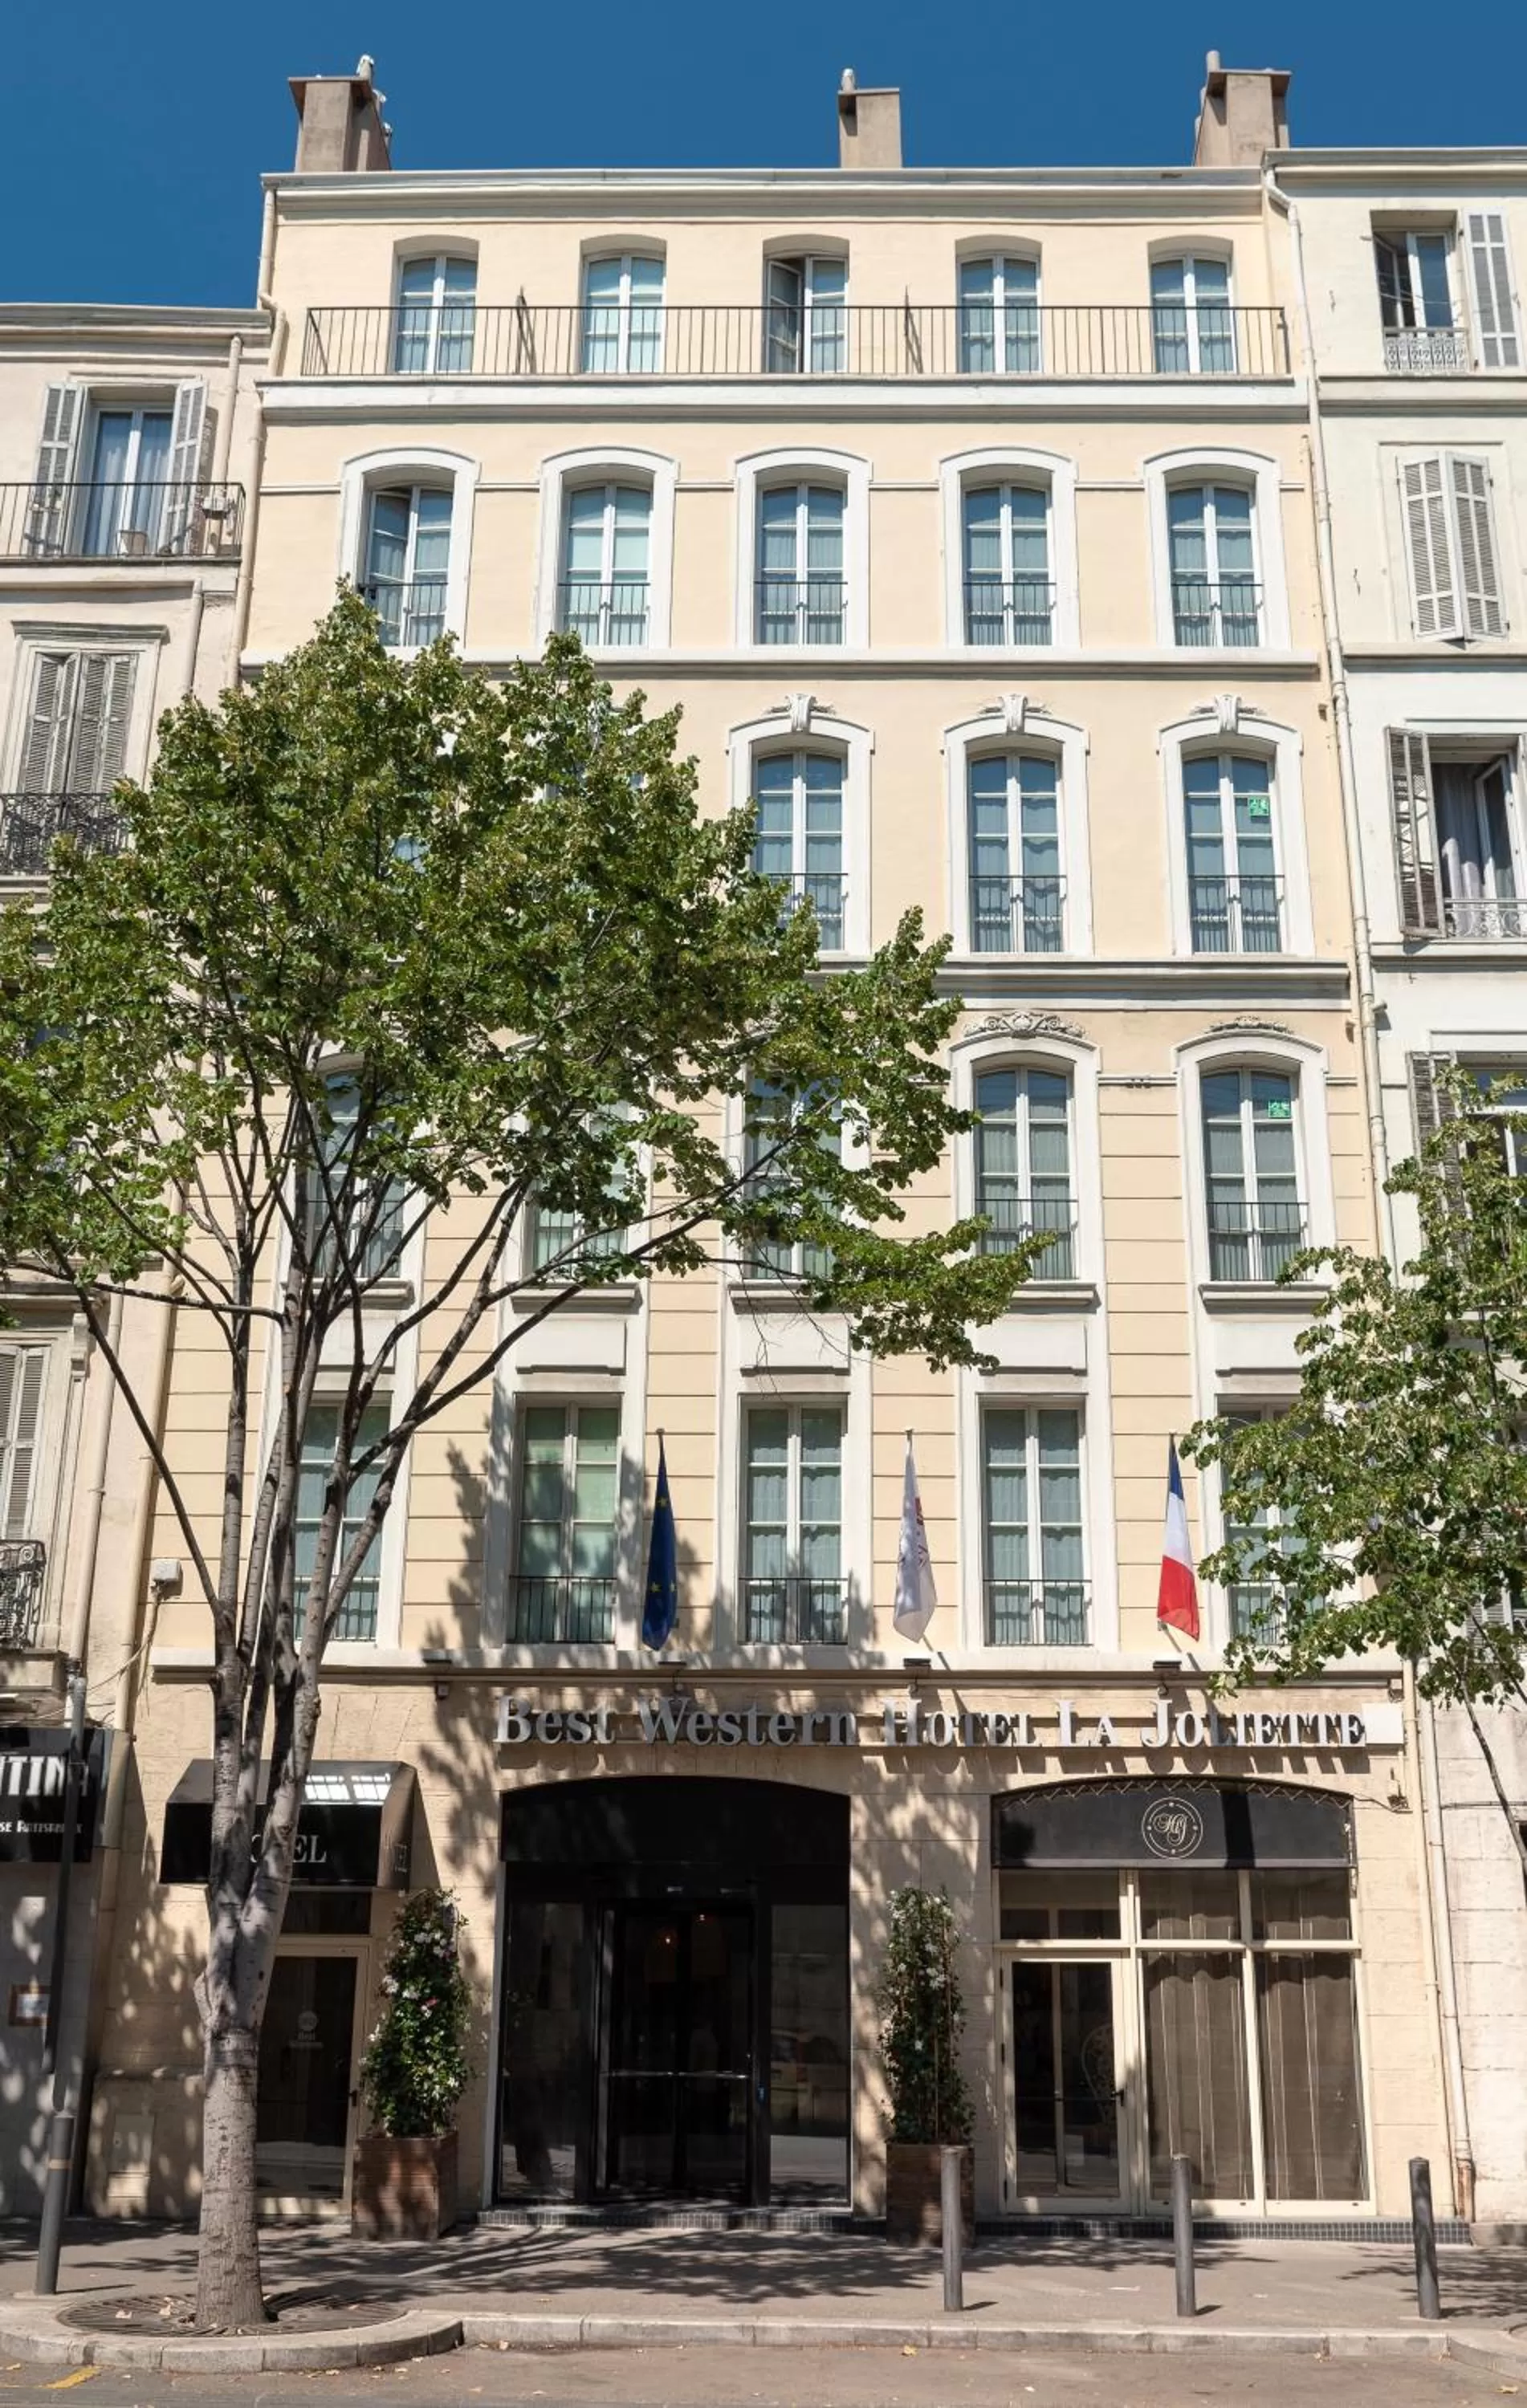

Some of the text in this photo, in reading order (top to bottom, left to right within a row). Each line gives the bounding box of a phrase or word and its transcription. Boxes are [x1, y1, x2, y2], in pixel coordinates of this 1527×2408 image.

[493, 1695, 1366, 1748] Best Western HOTEL LA JOLIETTE
